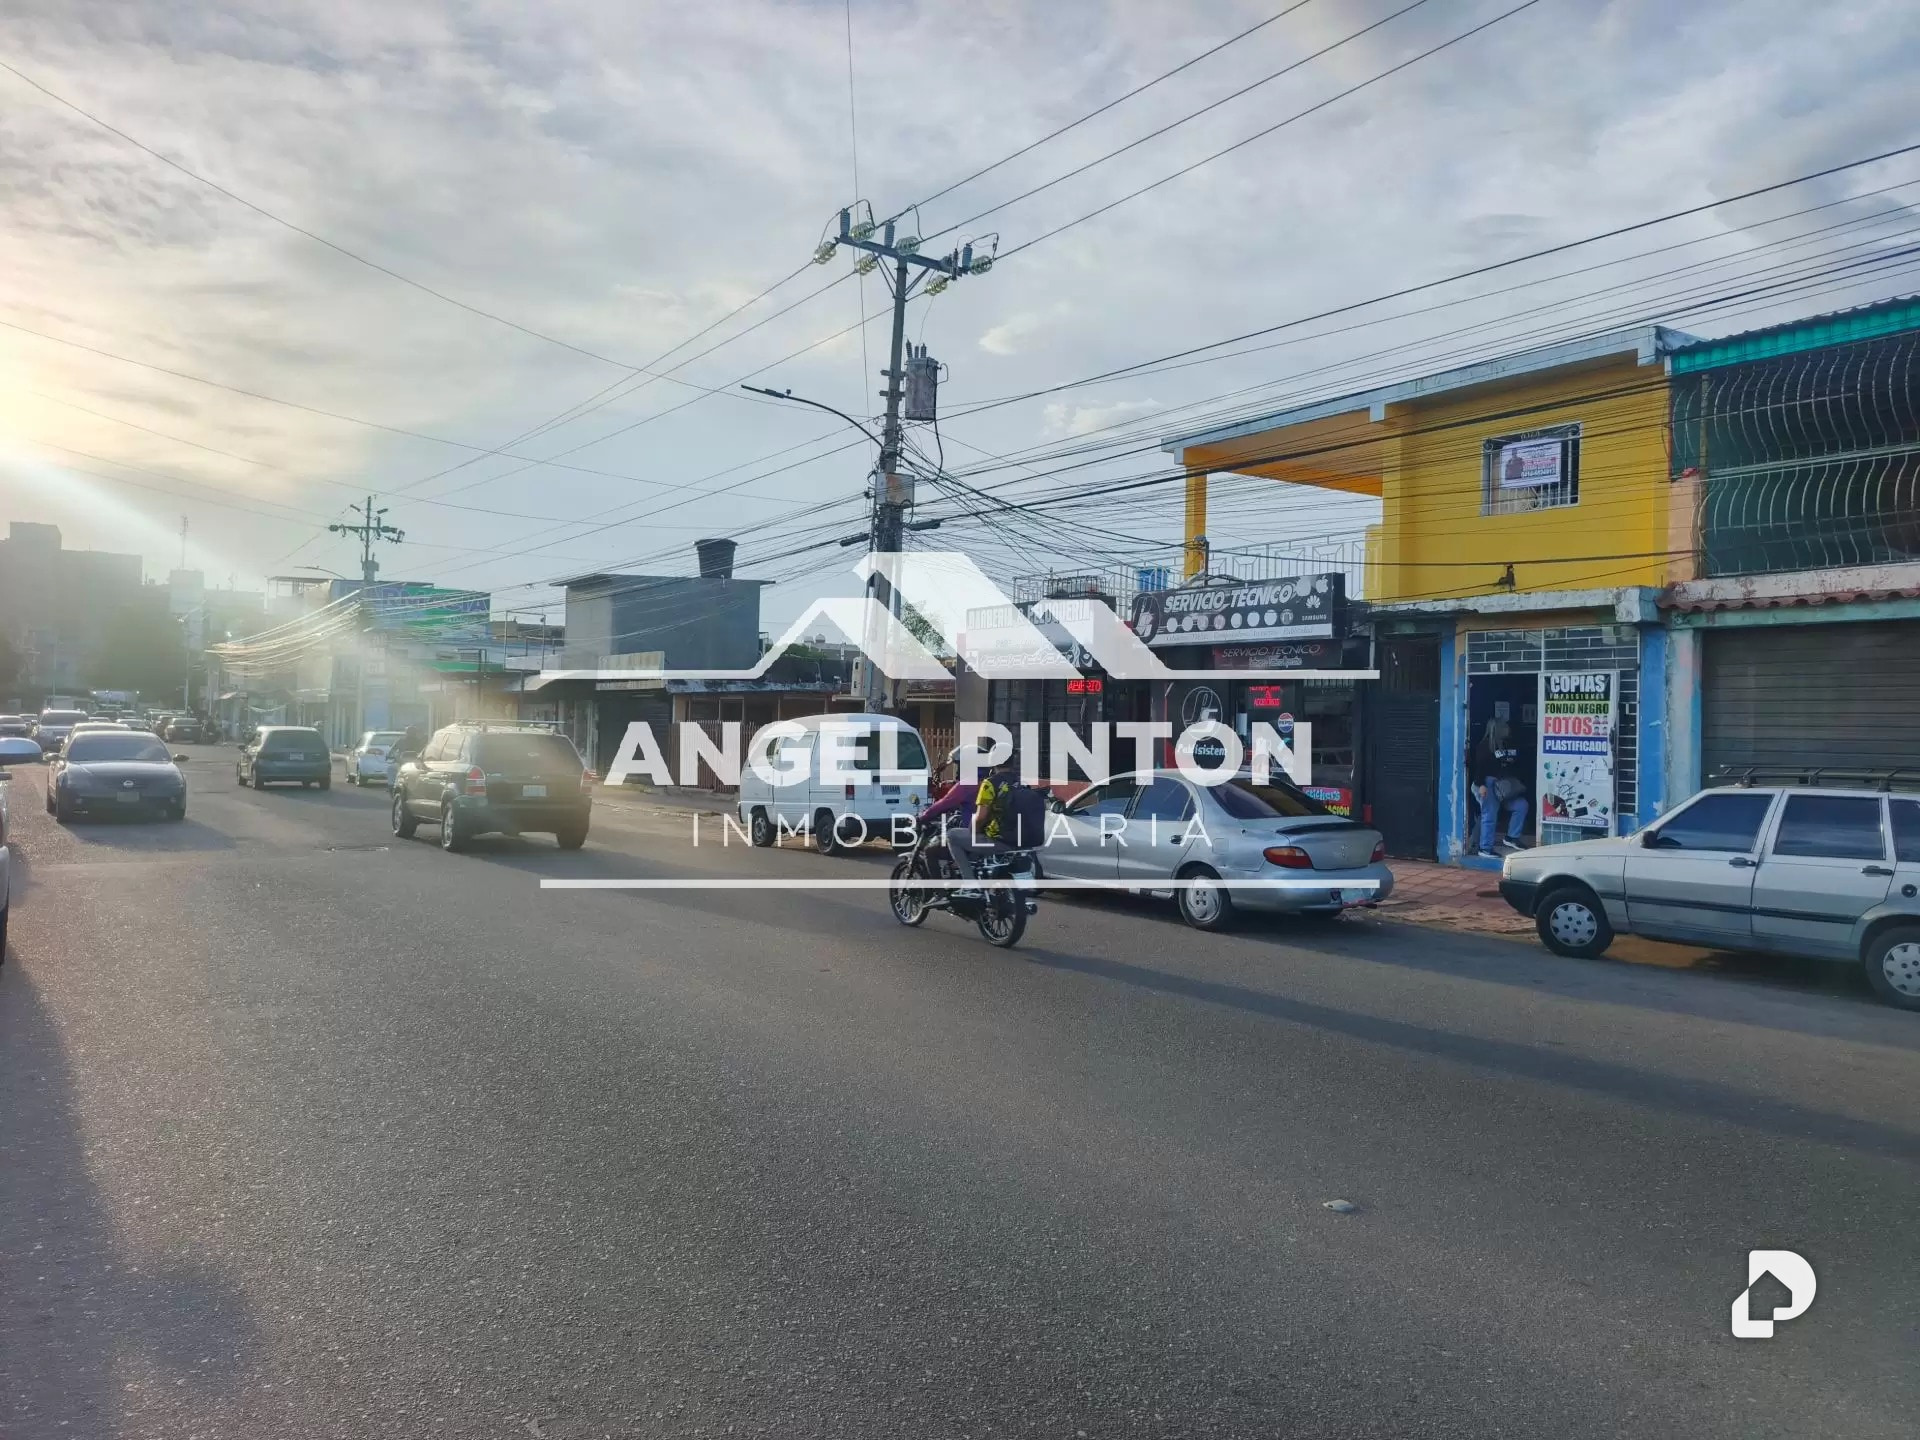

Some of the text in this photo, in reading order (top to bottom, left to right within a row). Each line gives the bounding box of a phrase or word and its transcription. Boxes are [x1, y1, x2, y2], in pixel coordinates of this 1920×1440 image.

[1163, 590, 1226, 614] SERVICIO
[1222, 647, 1269, 658] SERVICIO
[1550, 674, 1605, 693] COPIAS
[1544, 702, 1609, 715] FONDO NEGRO
[1544, 716, 1593, 735] FOTOS
[1546, 739, 1607, 753] PLASTIFICADO
[1325, 804, 1350, 817] ACION
